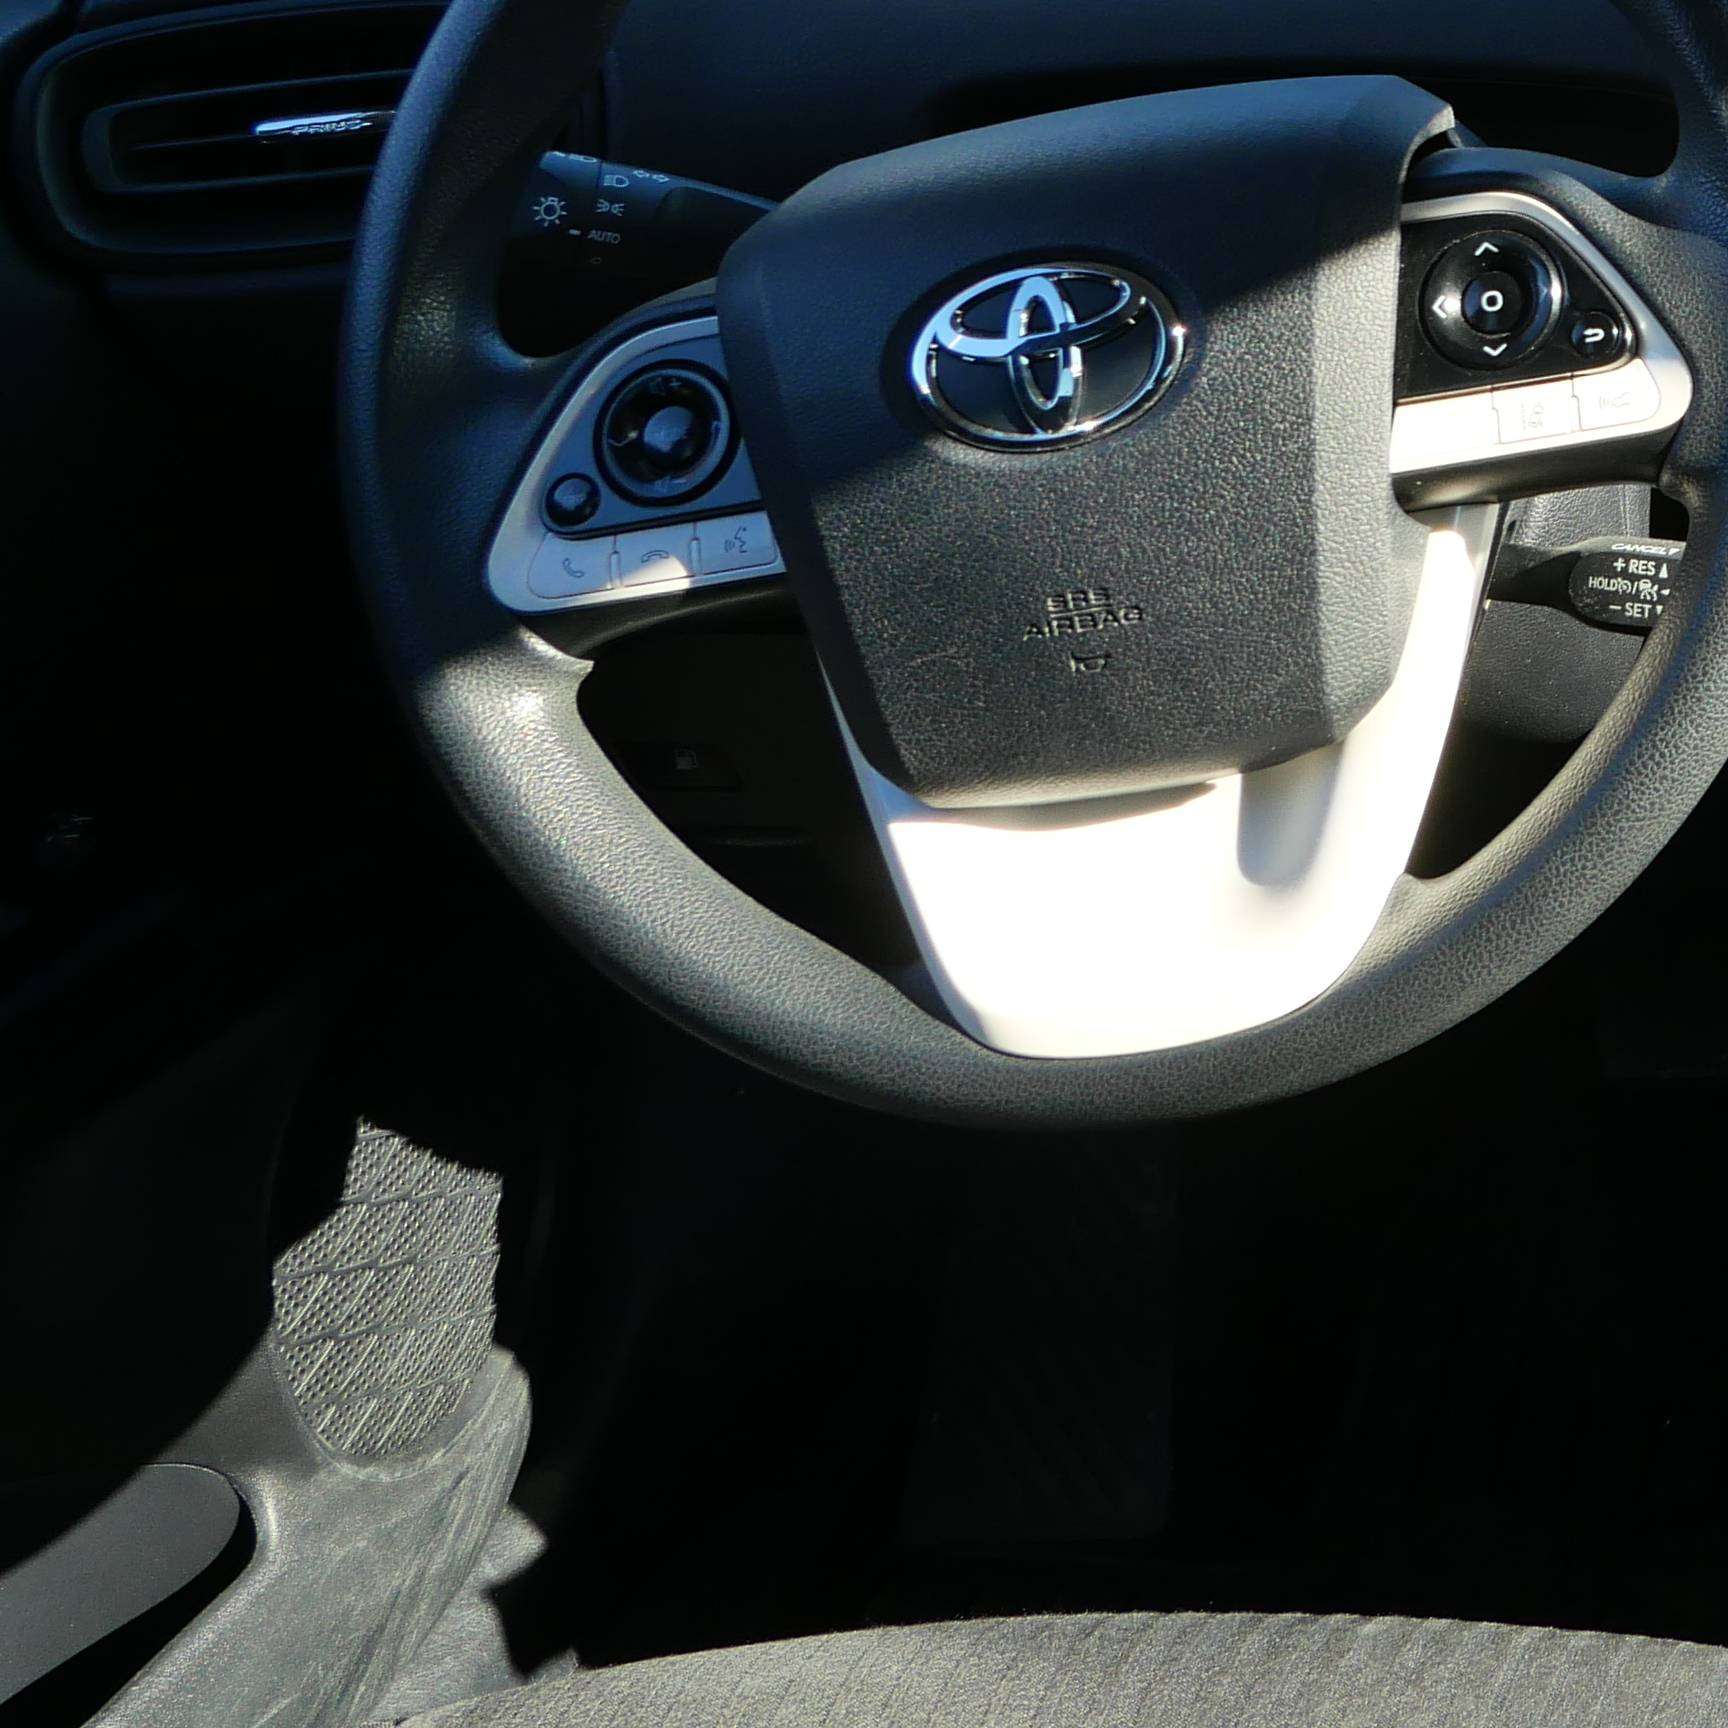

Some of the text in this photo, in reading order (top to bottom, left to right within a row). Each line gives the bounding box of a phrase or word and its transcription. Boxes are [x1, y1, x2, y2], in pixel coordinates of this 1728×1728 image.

[587, 228, 622, 245] AUTO
[1611, 542, 1668, 555] CANCEL
[1627, 558, 1657, 576] RES
[1588, 575, 1618, 592] HOLD
[1046, 589, 1108, 612] SRS
[1624, 603, 1653, 619] SET
[1022, 608, 1142, 641] AIRBAG
